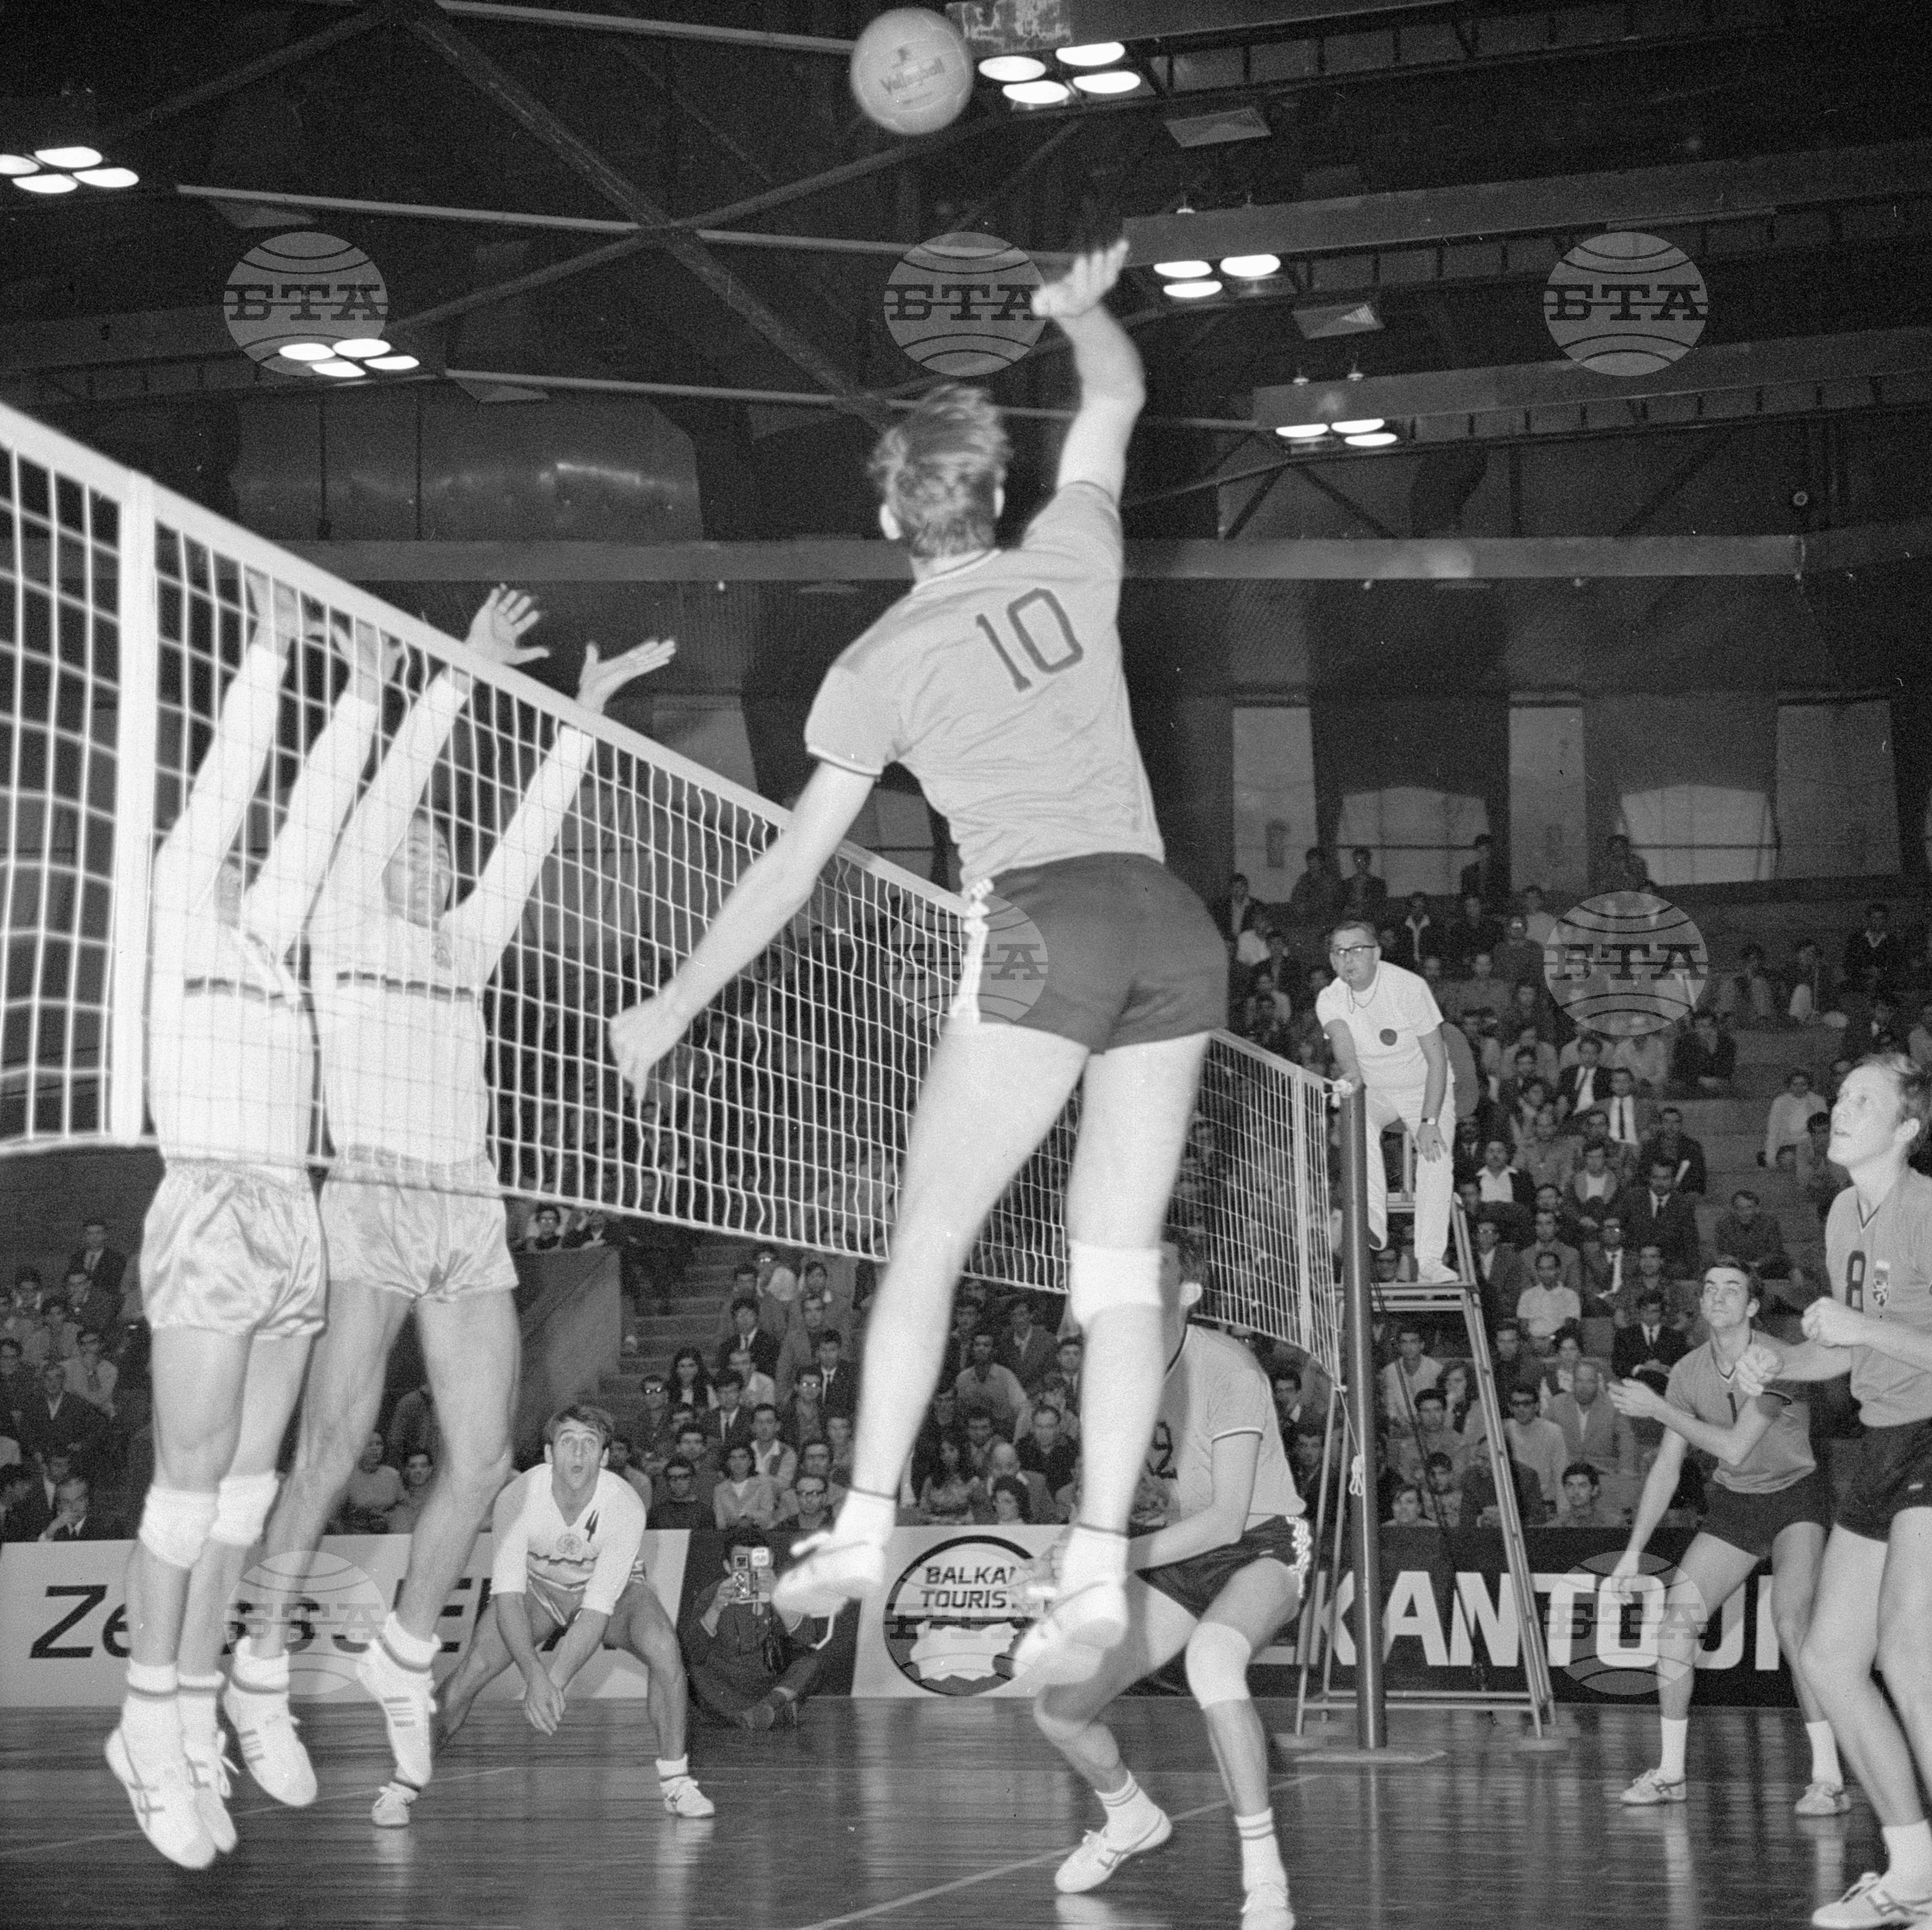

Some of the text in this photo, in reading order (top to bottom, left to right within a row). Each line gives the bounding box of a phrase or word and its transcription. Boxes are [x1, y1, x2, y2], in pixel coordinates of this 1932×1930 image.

[976, 587, 1084, 692] 10
[1846, 1250, 1867, 1313] 8
[584, 1509, 599, 1543] 4
[920, 1590, 1016, 1609] TOURIS
